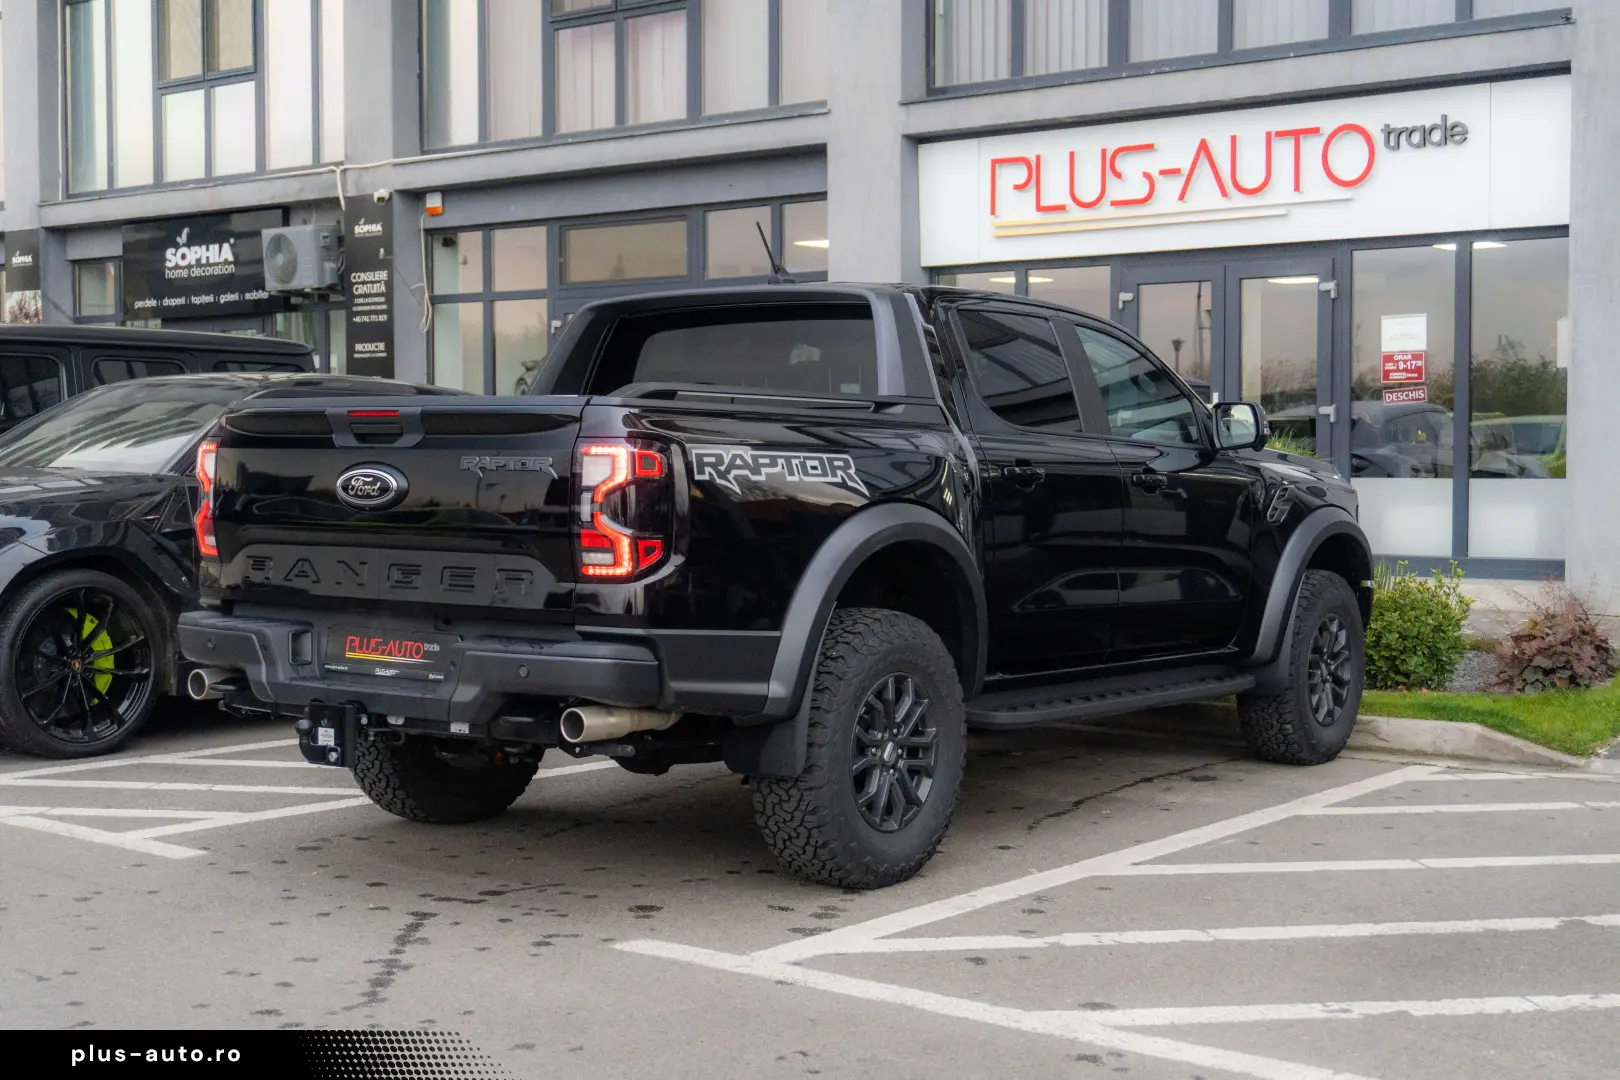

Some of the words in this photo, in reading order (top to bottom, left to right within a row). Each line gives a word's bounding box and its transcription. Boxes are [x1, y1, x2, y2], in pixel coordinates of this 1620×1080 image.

[990, 123, 1376, 216] PLUS-AUTO
[1381, 114, 1468, 151] trade
[354, 223, 383, 234] SOPHIA
[165, 243, 234, 268] SOPHIA
[165, 268, 189, 279] home
[190, 264, 235, 277] decoration
[135, 298, 157, 309] perdele
[163, 296, 186, 307] draperii
[220, 292, 239, 303] galerii
[245, 289, 269, 300] mobilier
[1385, 390, 1425, 402] DESCHIS
[460, 456, 558, 479] RAPTOR
[692, 450, 870, 497] RAPTOR
[349, 476, 381, 496] Ford
[242, 555, 534, 597] RANGER
[345, 635, 425, 659] PLUS-AUTO
